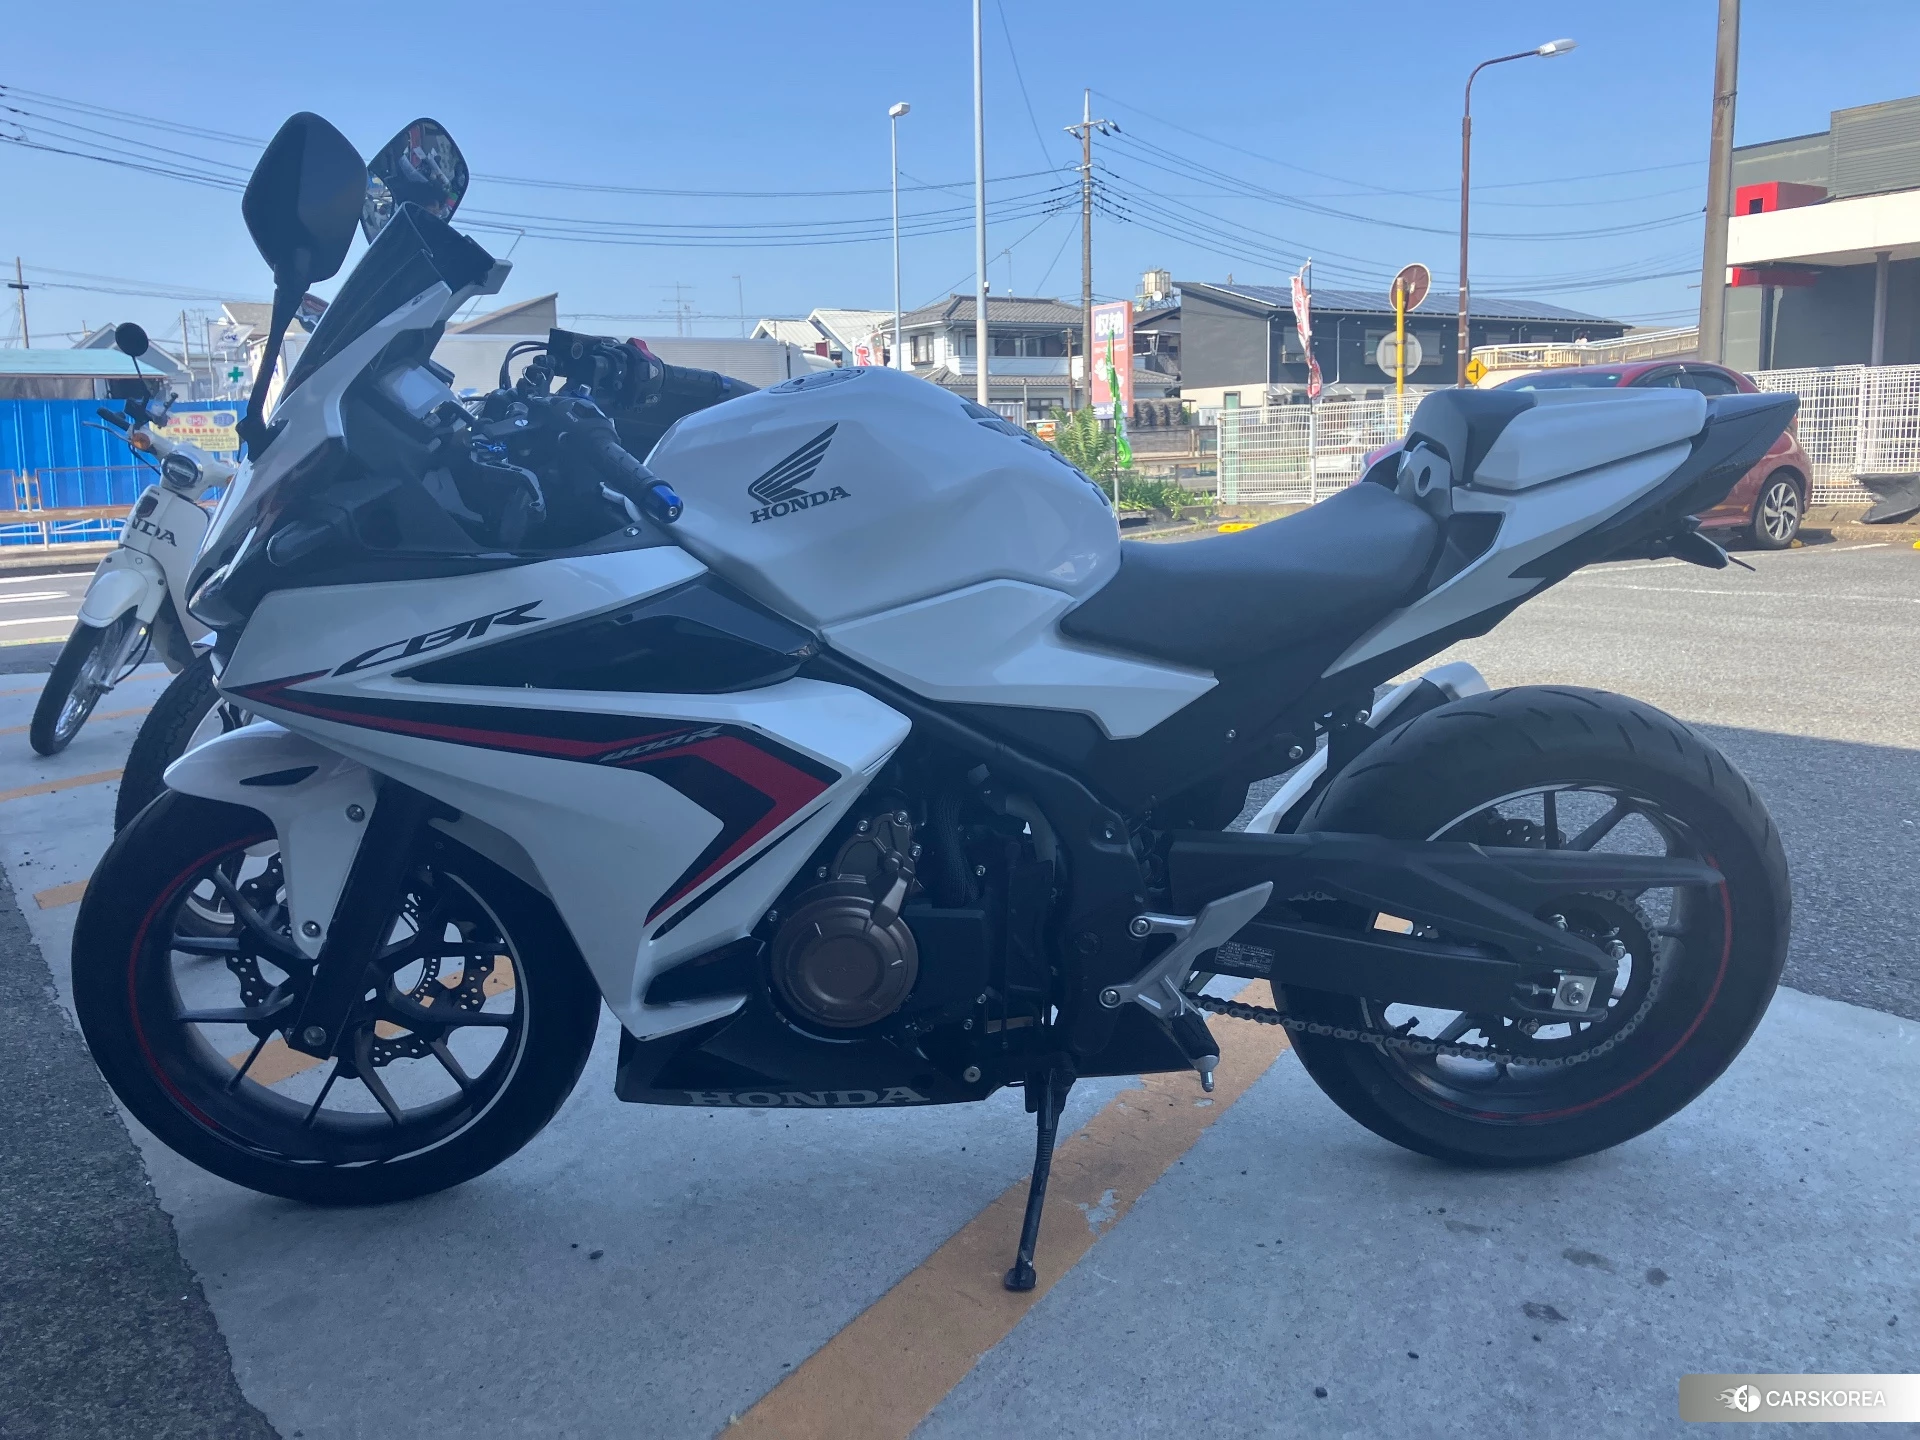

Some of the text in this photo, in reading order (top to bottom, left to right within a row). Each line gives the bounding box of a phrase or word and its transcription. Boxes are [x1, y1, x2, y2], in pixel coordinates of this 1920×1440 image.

[750, 485, 851, 524] HONDA
[331, 600, 547, 677] CBR
[684, 1086, 930, 1106] HONDA
